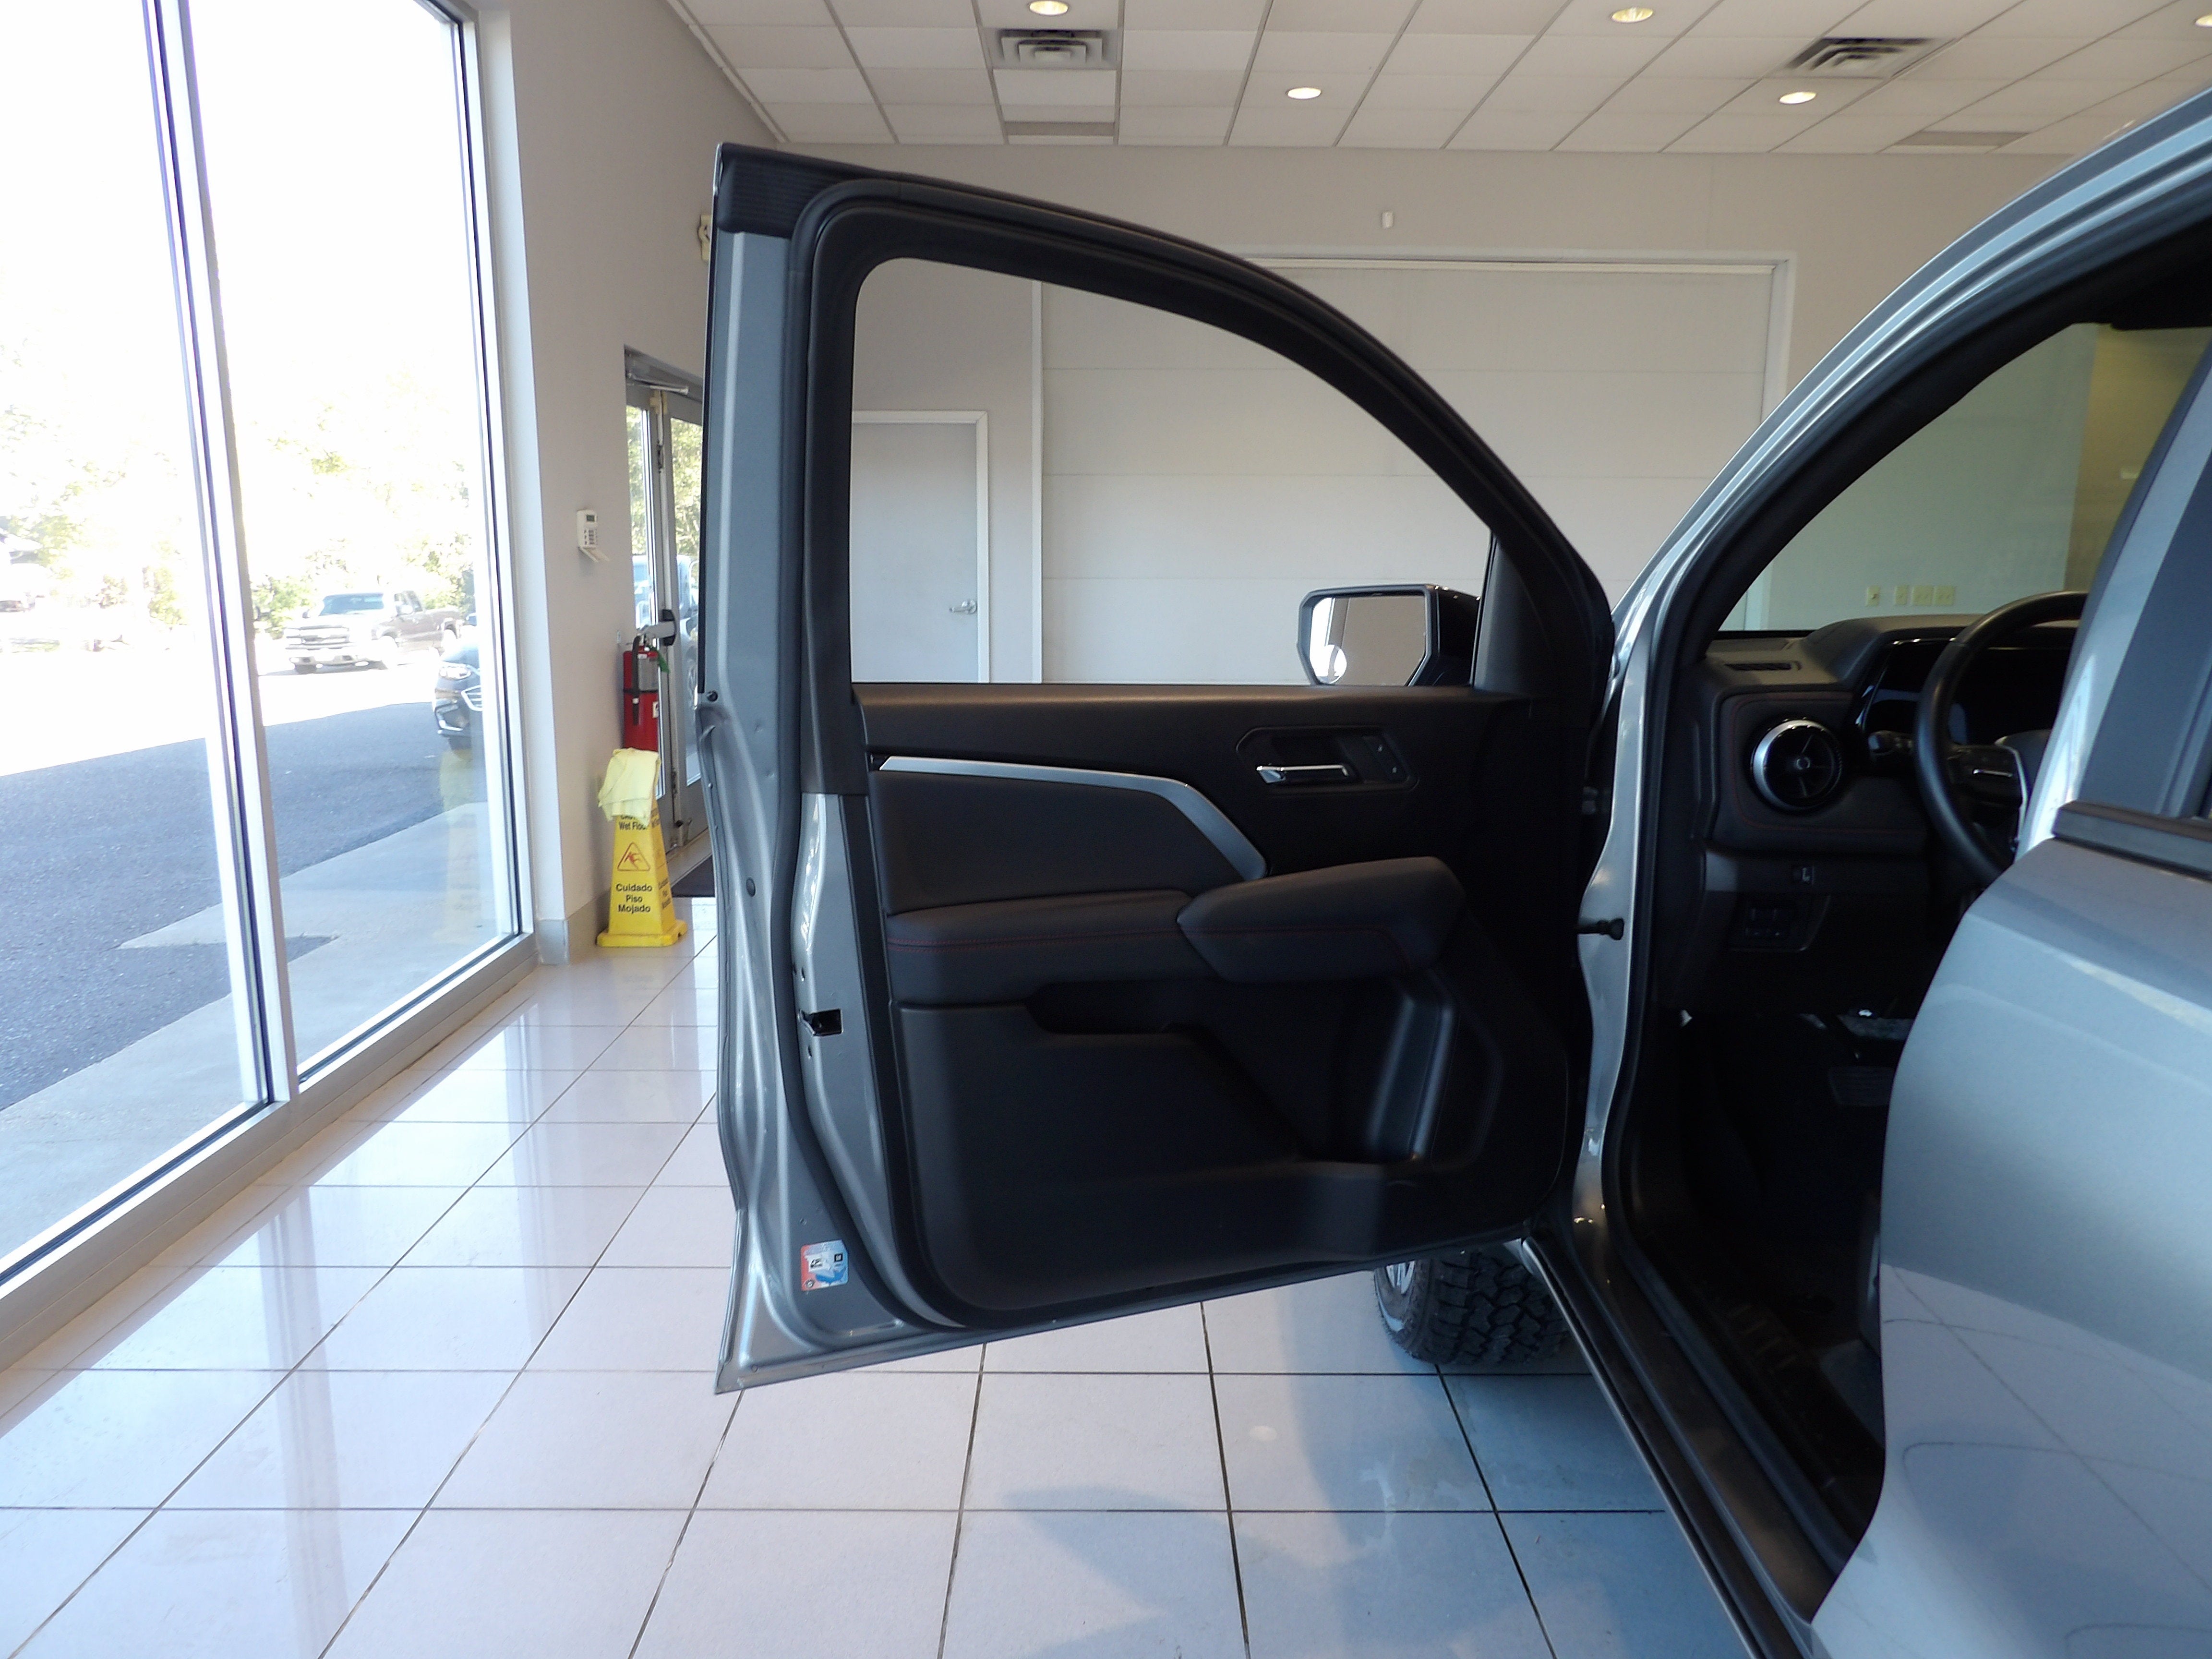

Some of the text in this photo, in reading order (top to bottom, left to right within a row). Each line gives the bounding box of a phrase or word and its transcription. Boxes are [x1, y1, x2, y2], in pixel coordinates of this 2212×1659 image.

[619, 822, 631, 830] Wet
[632, 821, 648, 830] Floo
[616, 883, 652, 891] Cuidado
[625, 894, 643, 903] Piso
[618, 904, 651, 914] Mojado
